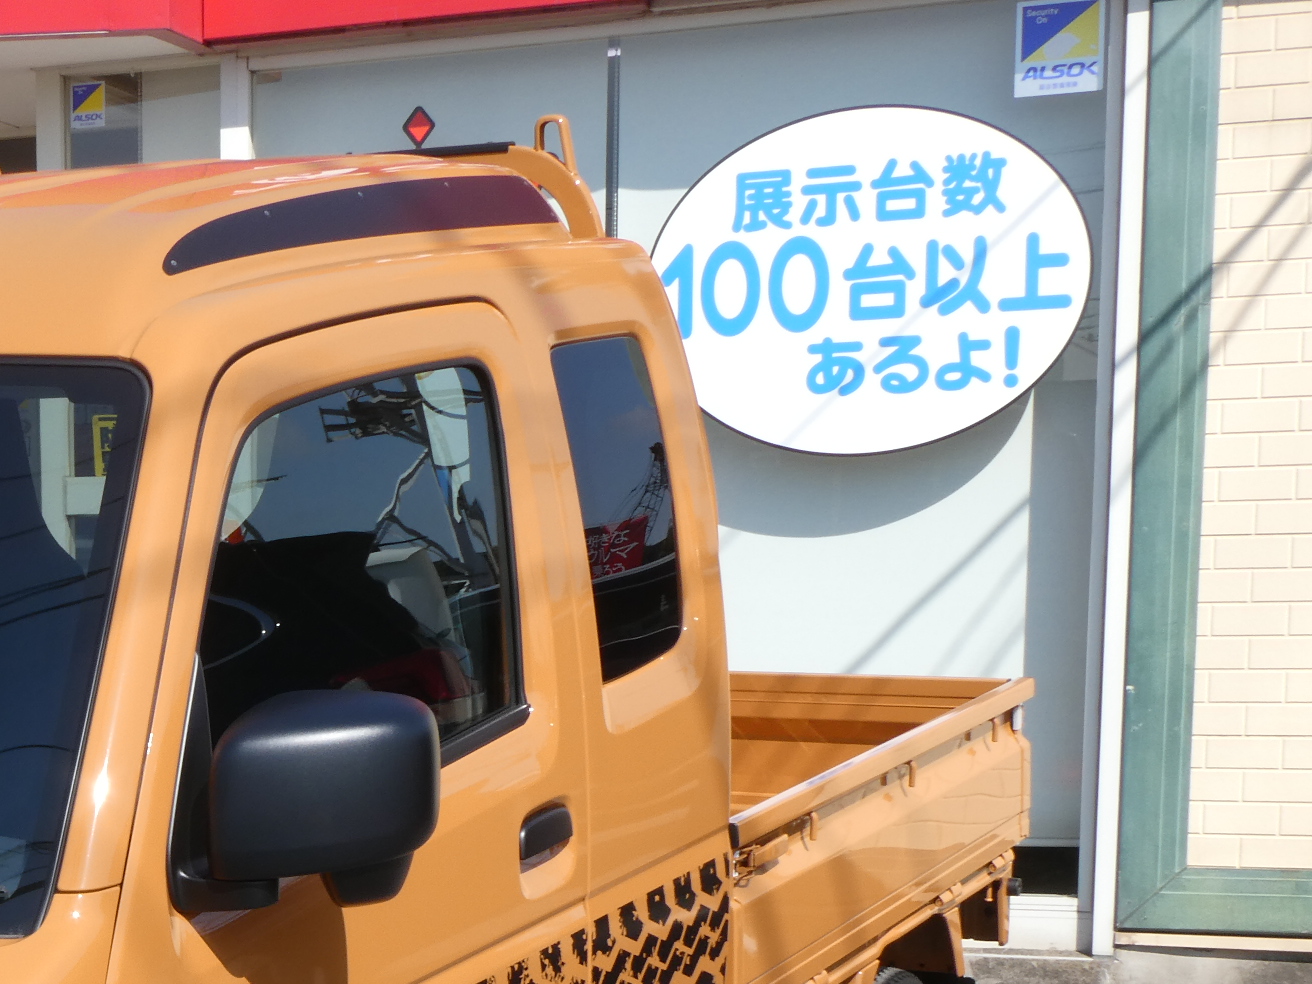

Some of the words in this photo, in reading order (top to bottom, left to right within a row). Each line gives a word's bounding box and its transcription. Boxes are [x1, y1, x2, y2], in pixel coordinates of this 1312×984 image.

[1021, 61, 1099, 82] ALSOK
[73, 112, 103, 121] ALSOK
[731, 150, 1008, 234] 展示台数
[660, 231, 1073, 340] 100台以上
[805, 325, 1021, 397] あるよ!
